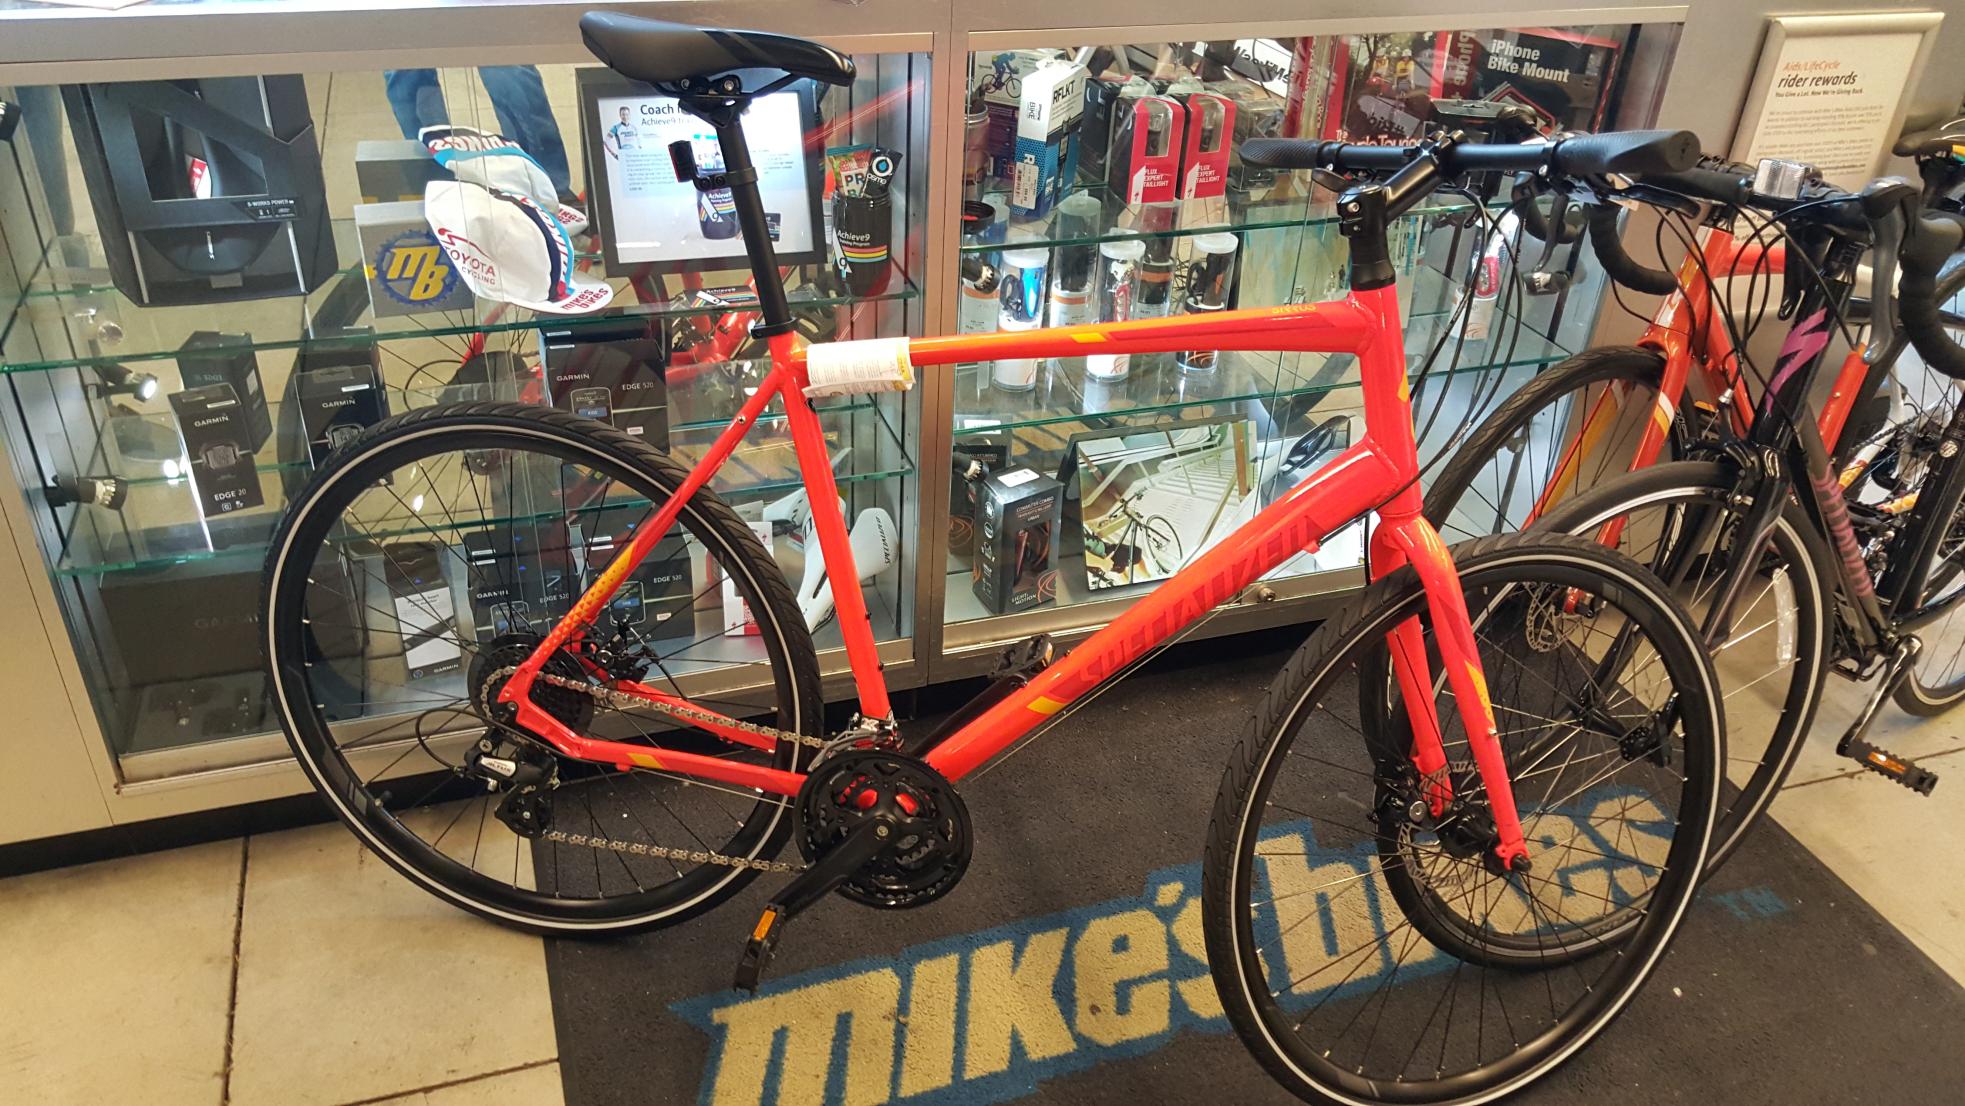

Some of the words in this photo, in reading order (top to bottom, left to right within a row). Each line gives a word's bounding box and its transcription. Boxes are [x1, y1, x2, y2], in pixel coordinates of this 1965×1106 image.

[1491, 40, 1541, 61] iPhone
[1487, 55, 1519, 74] Bike
[1522, 62, 1570, 83] Mount
[1778, 74, 1808, 88] rider
[1809, 71, 1858, 87] rewards
[1052, 80, 1076, 105] RFLKT
[640, 104, 674, 115] Coach
[867, 173, 887, 185] osmo
[1143, 180, 1169, 188] TAILLIGHT
[837, 230, 871, 241] Achieve9
[444, 246, 496, 277] TOYOTA
[461, 266, 496, 286] CYCLING
[557, 373, 590, 382] GARMIN
[622, 382, 641, 391] EDGE
[642, 381, 654, 389] 520
[322, 399, 356, 408] GARMIN
[194, 415, 229, 428] GARMIN
[214, 490, 236, 502] EDGE
[540, 595, 557, 604] EDGE
[559, 592, 569, 600] 520
[1079, 516, 1310, 683] SPECIALIZED
[433, 663, 459, 674] GARMIN
